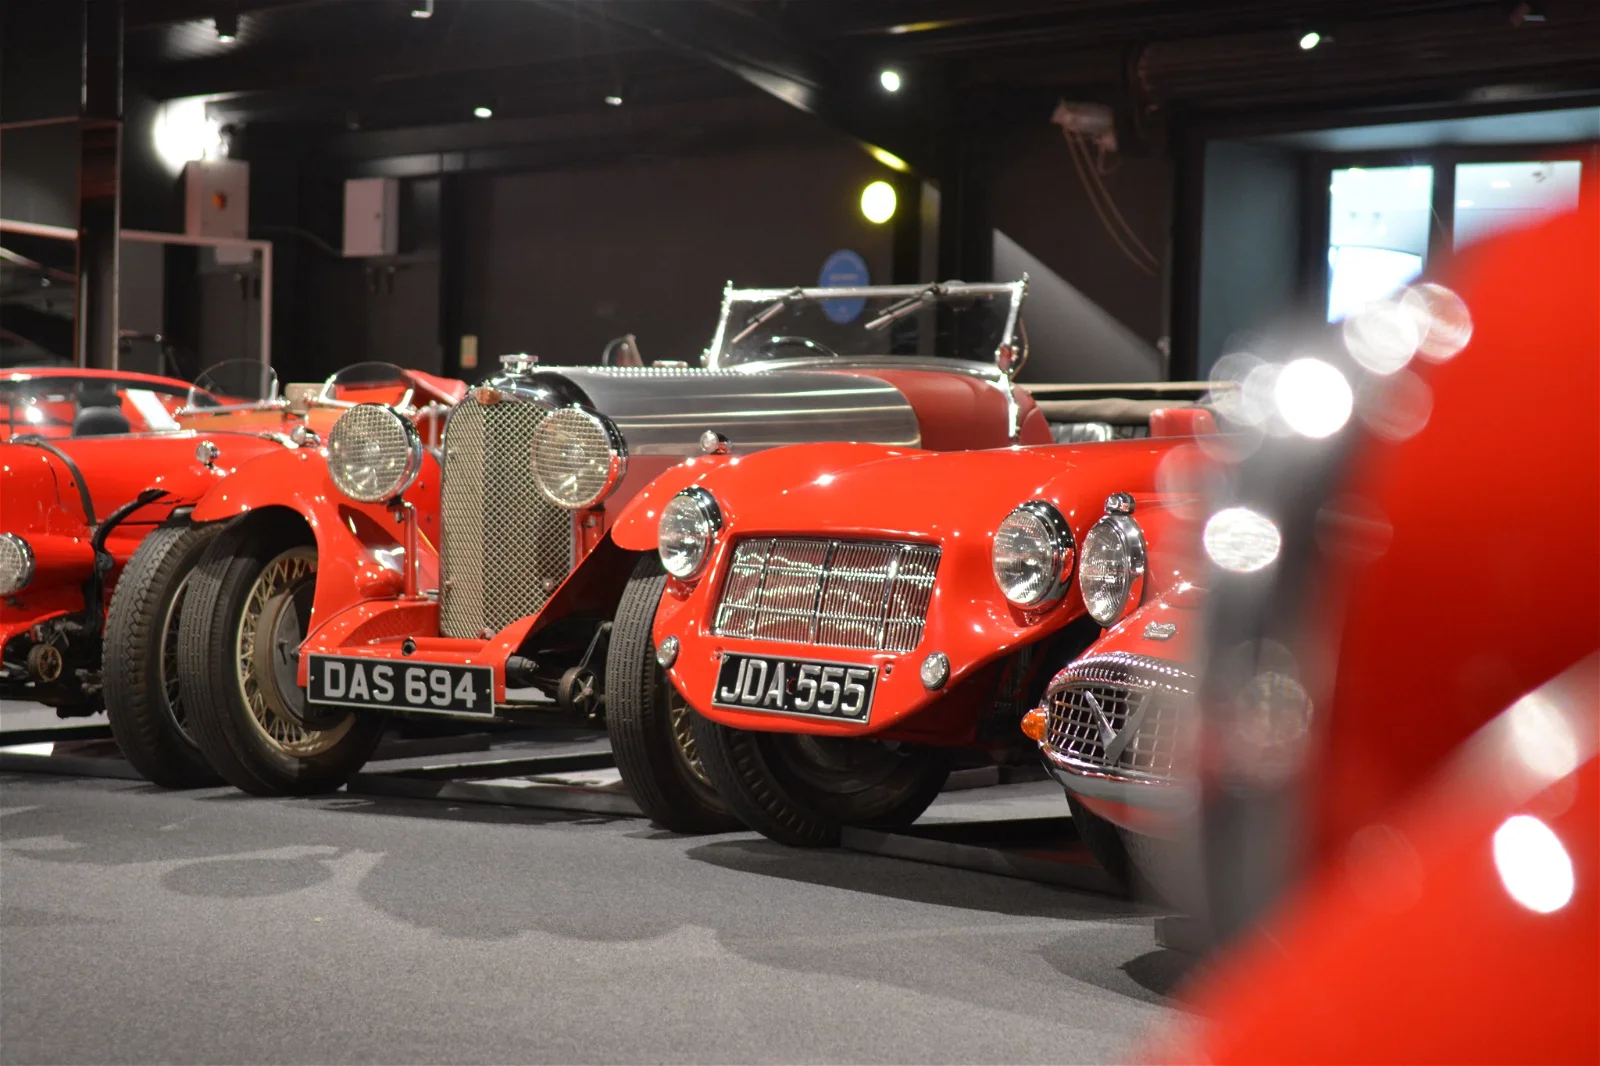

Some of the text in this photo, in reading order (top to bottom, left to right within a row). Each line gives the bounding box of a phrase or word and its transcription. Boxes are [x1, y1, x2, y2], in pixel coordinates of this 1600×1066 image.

[324, 661, 477, 708] DAS 694
[720, 658, 870, 716] JDA 555
